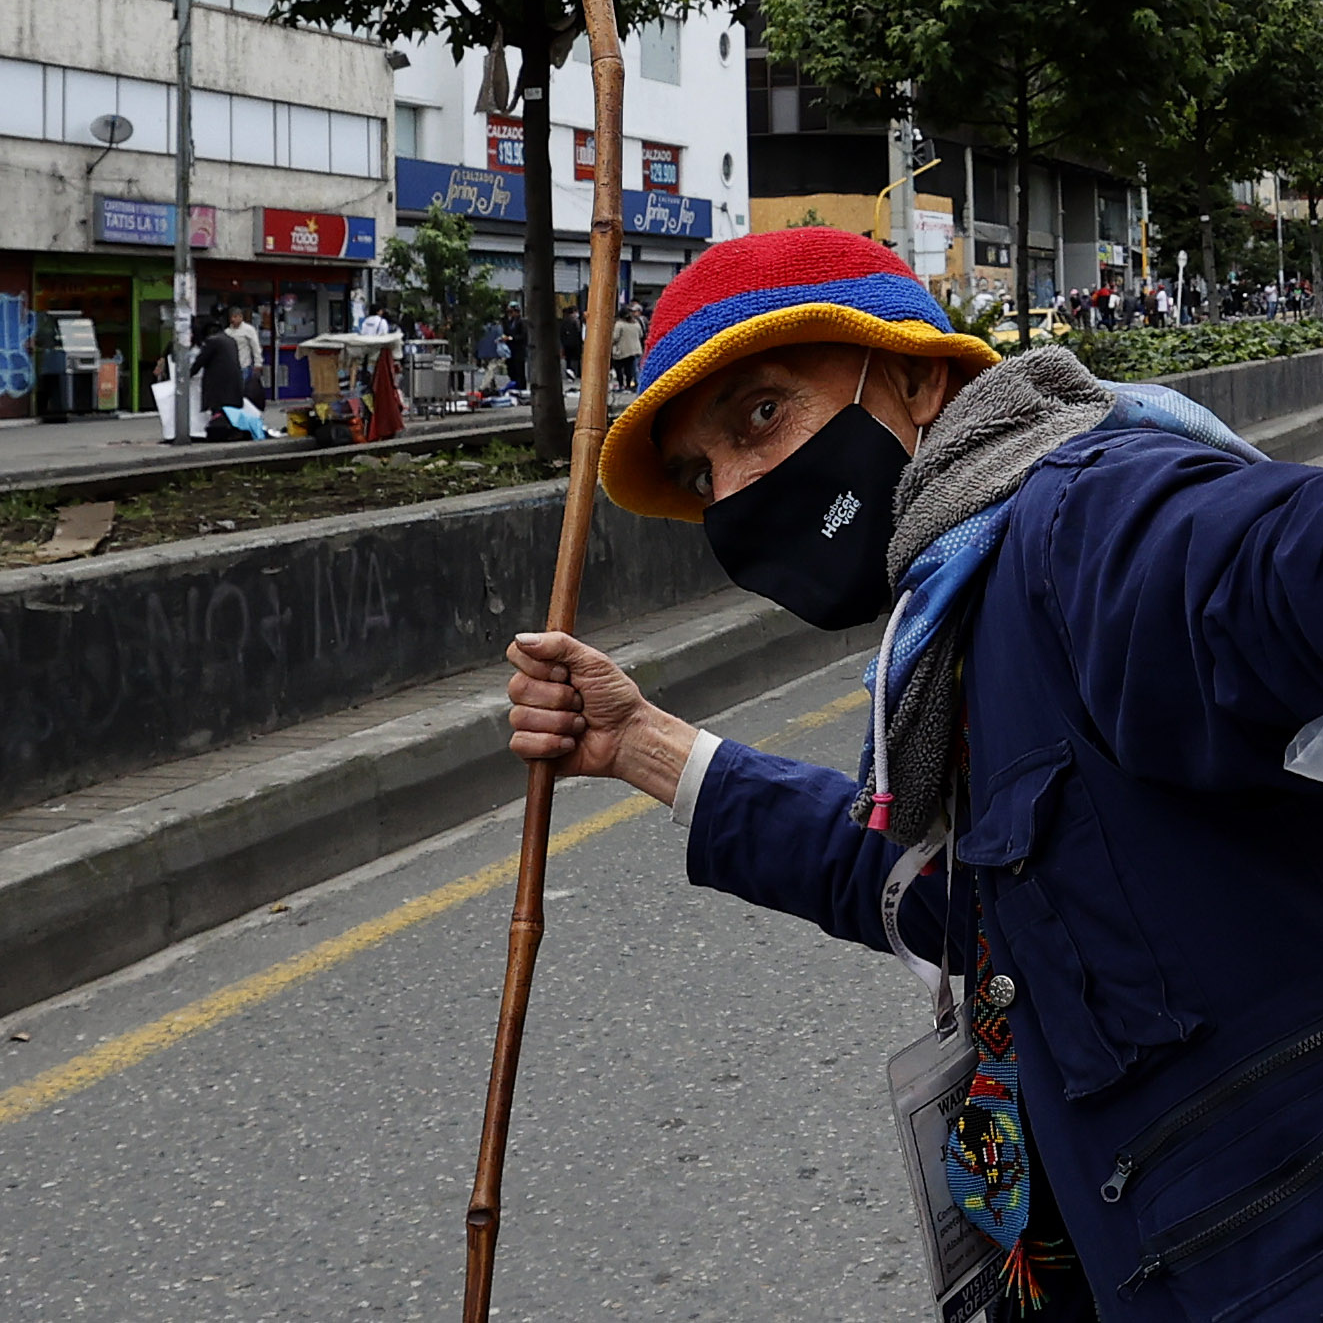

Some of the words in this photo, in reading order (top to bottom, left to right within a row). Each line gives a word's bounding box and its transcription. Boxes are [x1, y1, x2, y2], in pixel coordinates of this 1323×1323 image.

[137, 216, 152, 232] LA
[821, 490, 855, 538] Hacer
[823, 493, 844, 522] Saber
[842, 499, 861, 525] vale
